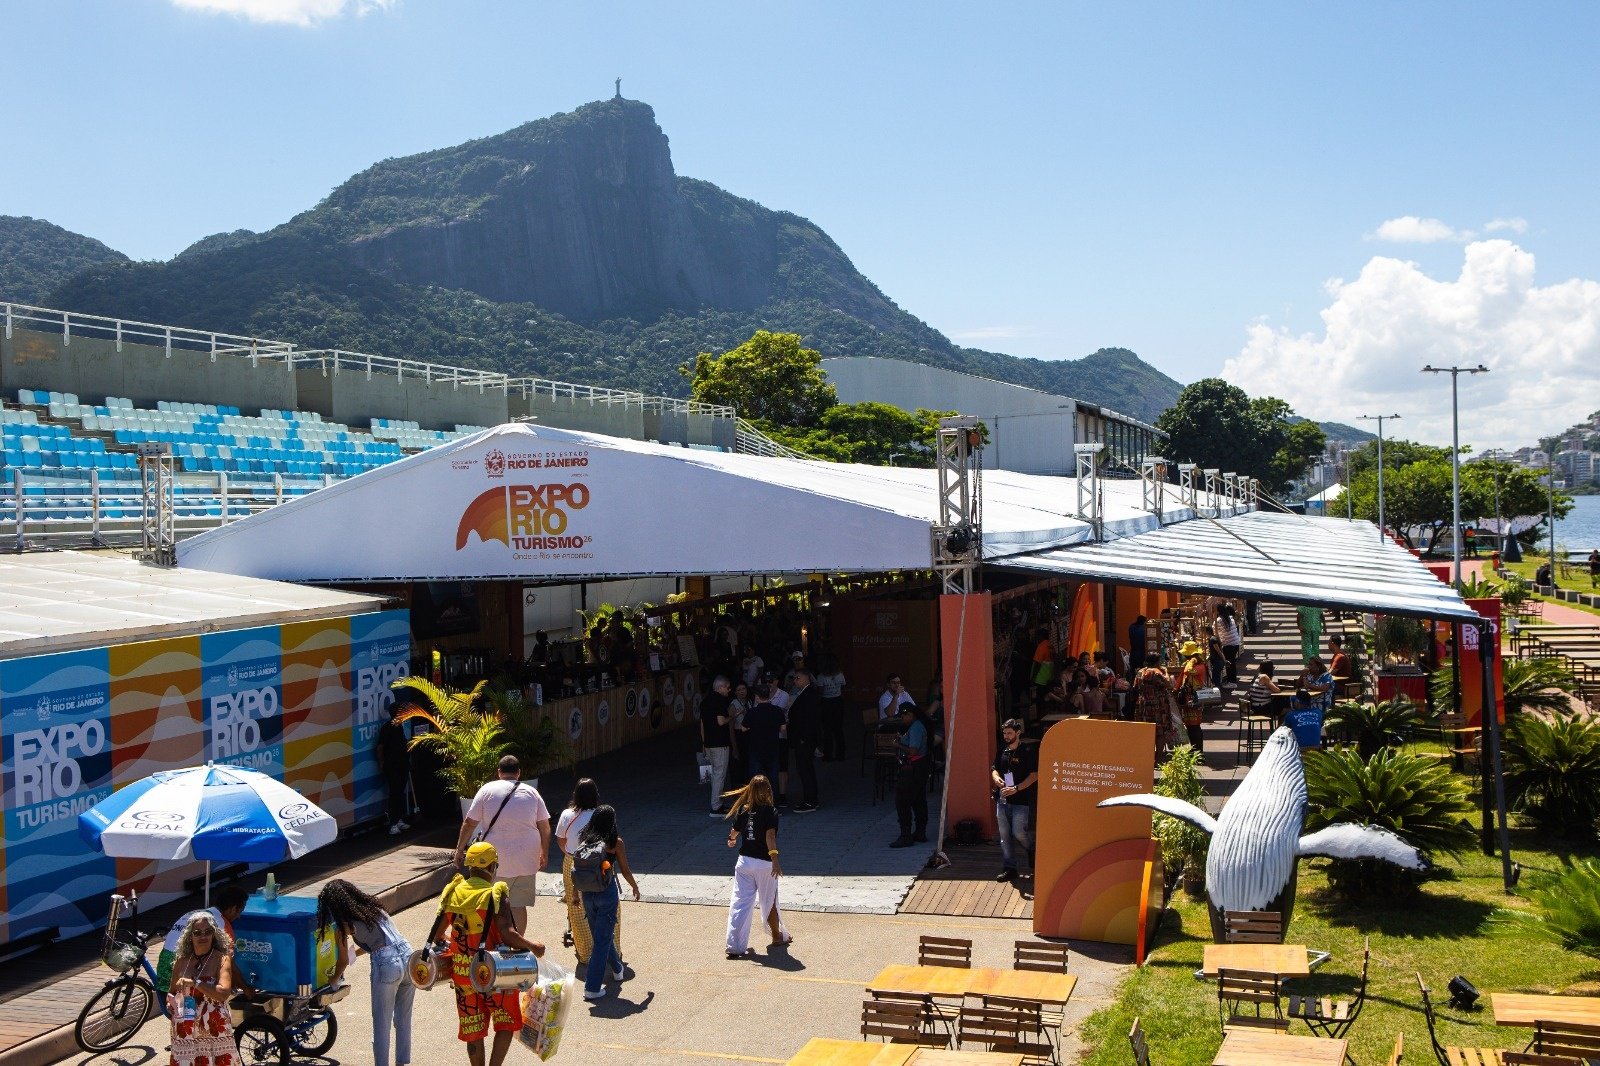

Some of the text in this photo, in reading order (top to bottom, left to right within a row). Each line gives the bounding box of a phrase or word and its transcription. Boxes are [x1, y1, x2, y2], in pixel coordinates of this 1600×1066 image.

[507, 457, 589, 469] RIO DE JANEIRO
[508, 482, 590, 510] EXPO
[510, 507, 568, 535] RIO
[511, 535, 593, 550] TURISMO 26
[539, 552, 551, 560] Rio
[238, 666, 278, 680] RIO DE JANEIRO
[358, 660, 410, 695] EXPO
[52, 697, 105, 712] RIO DE JANEIRO
[210, 685, 278, 723] EXPO
[13, 719, 105, 763] EXPO
[211, 718, 261, 761] RIO
[1062, 761, 1081, 769] FEIRA
[1091, 764, 1135, 773] ARTESANATO
[1076, 770, 1116, 779] CERVEJEIRO
[14, 757, 82, 809] RIO
[1061, 785, 1099, 793] BANHEIROS
[1062, 777, 1083, 785] PALCO
[1119, 781, 1143, 789] SHOWS
[16, 794, 99, 830] TURISMO
[120, 822, 184, 832] CEDAE
[283, 809, 322, 832] CEDAE
[232, 826, 276, 834] HIDRATAÇÃO
